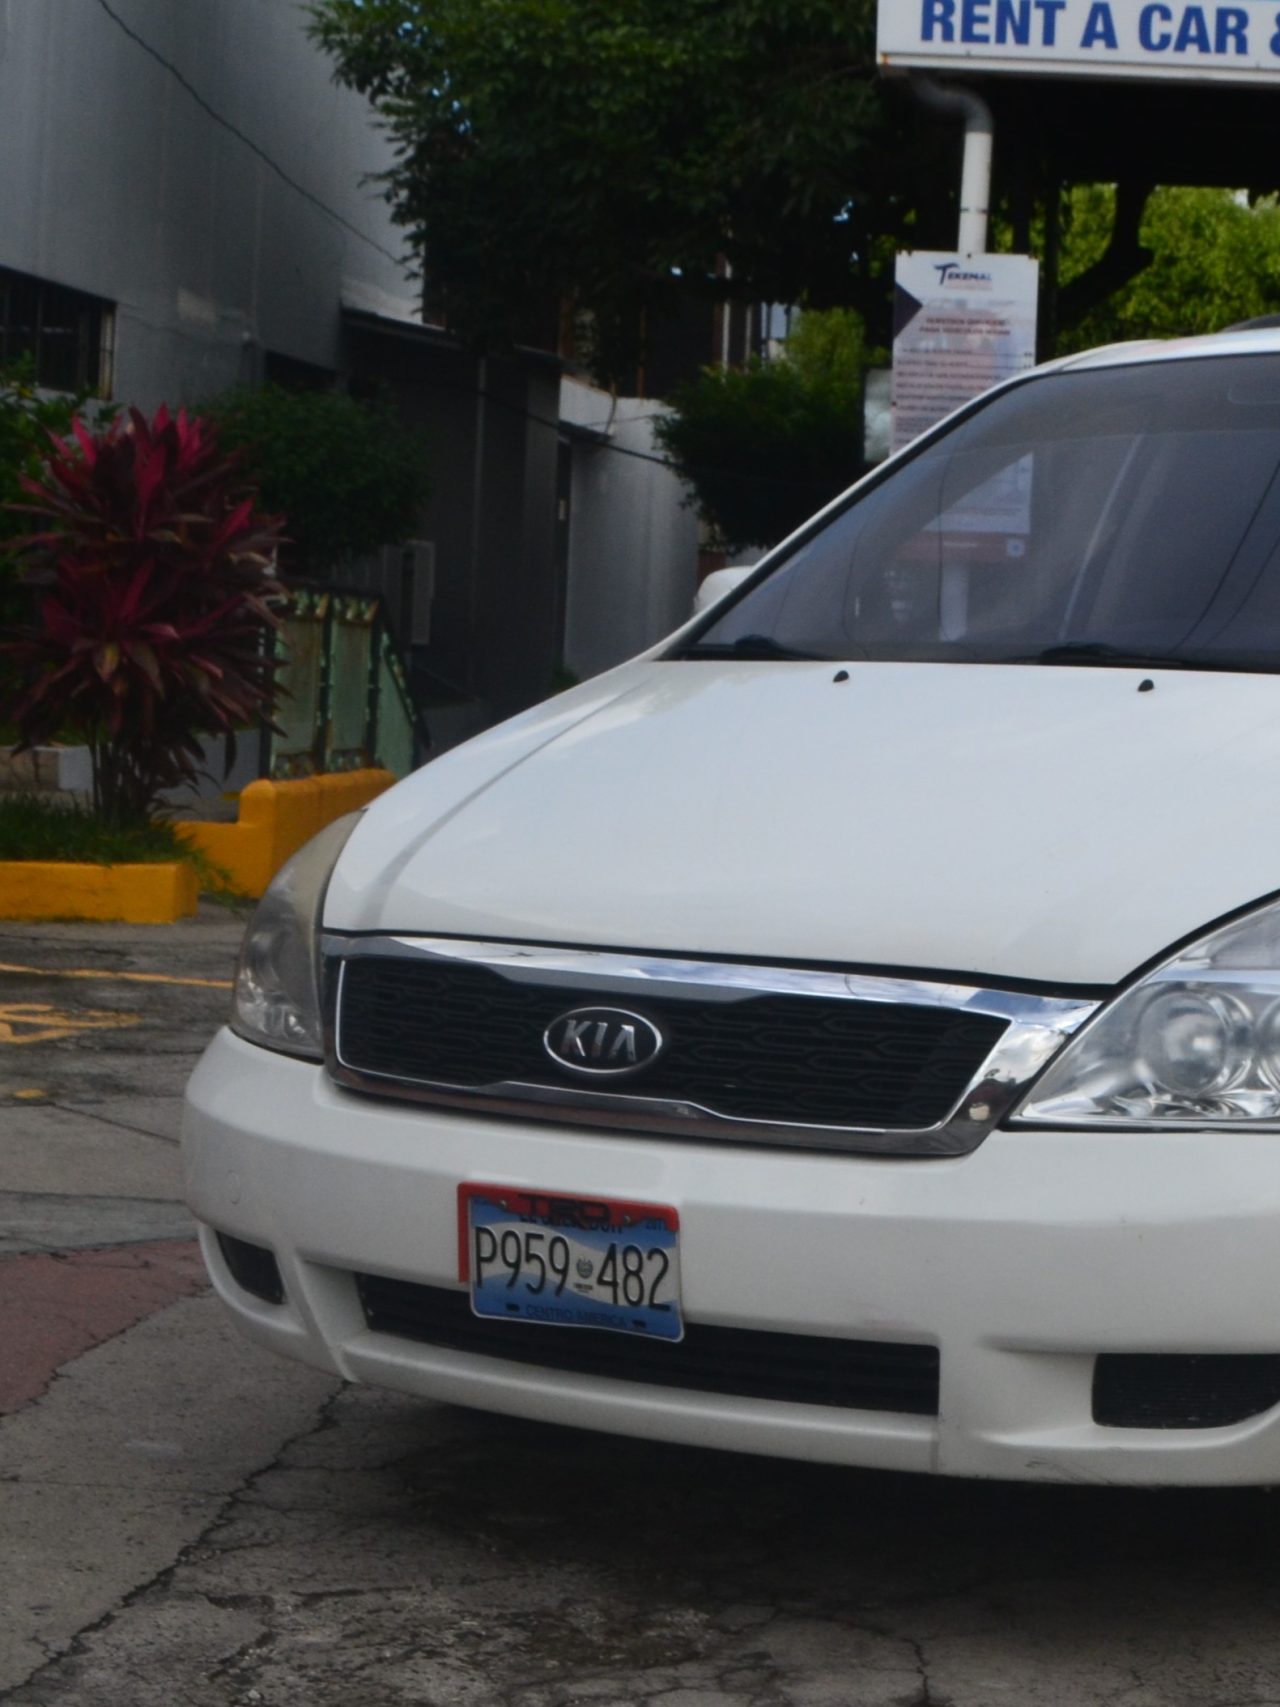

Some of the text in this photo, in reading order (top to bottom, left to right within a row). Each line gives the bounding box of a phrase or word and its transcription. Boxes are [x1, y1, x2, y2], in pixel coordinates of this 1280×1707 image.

[921, 0, 1067, 45] RENT
[1080, 1, 1118, 49] A
[1138, 3, 1250, 54] CAR
[559, 1018, 637, 1062] KIA
[474, 1226, 672, 1312] P959 482
